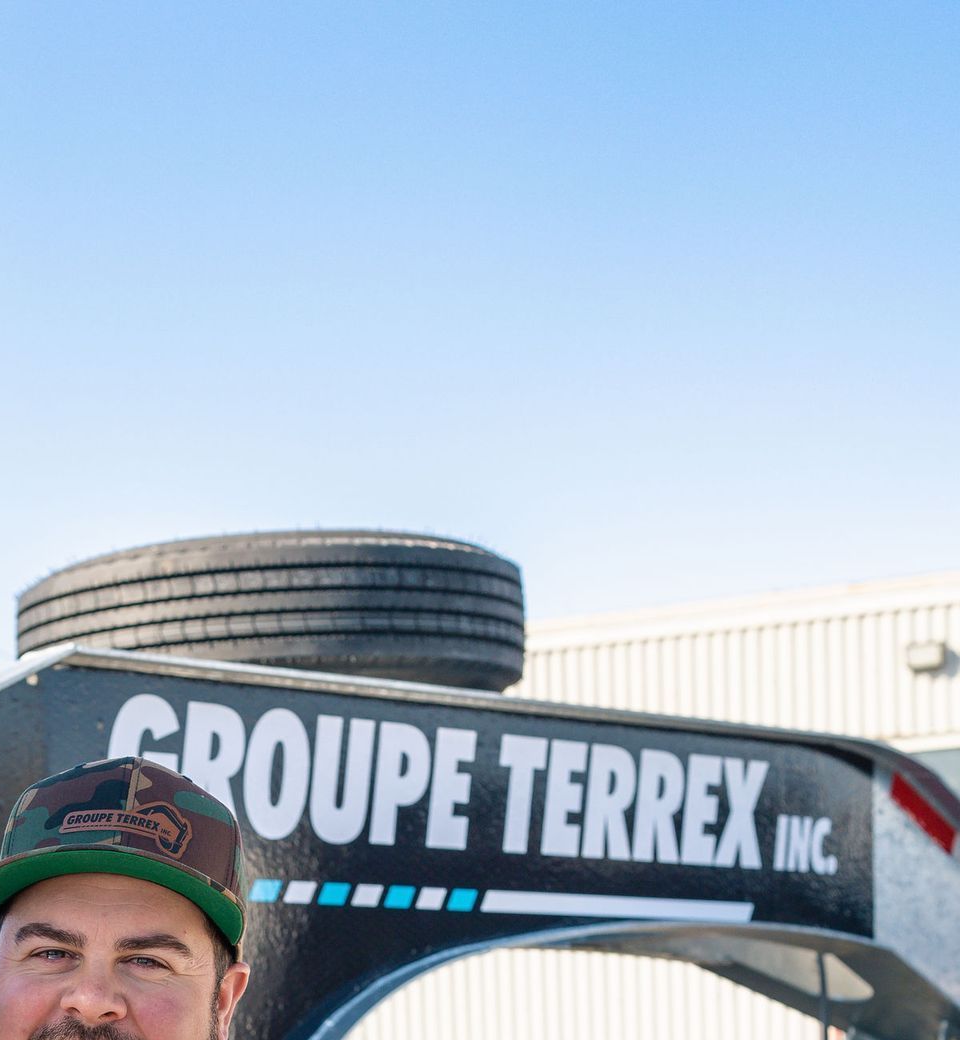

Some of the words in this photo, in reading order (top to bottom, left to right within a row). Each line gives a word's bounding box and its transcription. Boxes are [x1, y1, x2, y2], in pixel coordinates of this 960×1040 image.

[67, 813, 114, 825] GROUPE
[116, 813, 160, 832] TERREX
[499, 733, 770, 870] TERREX
[773, 814, 839, 875] INC.
